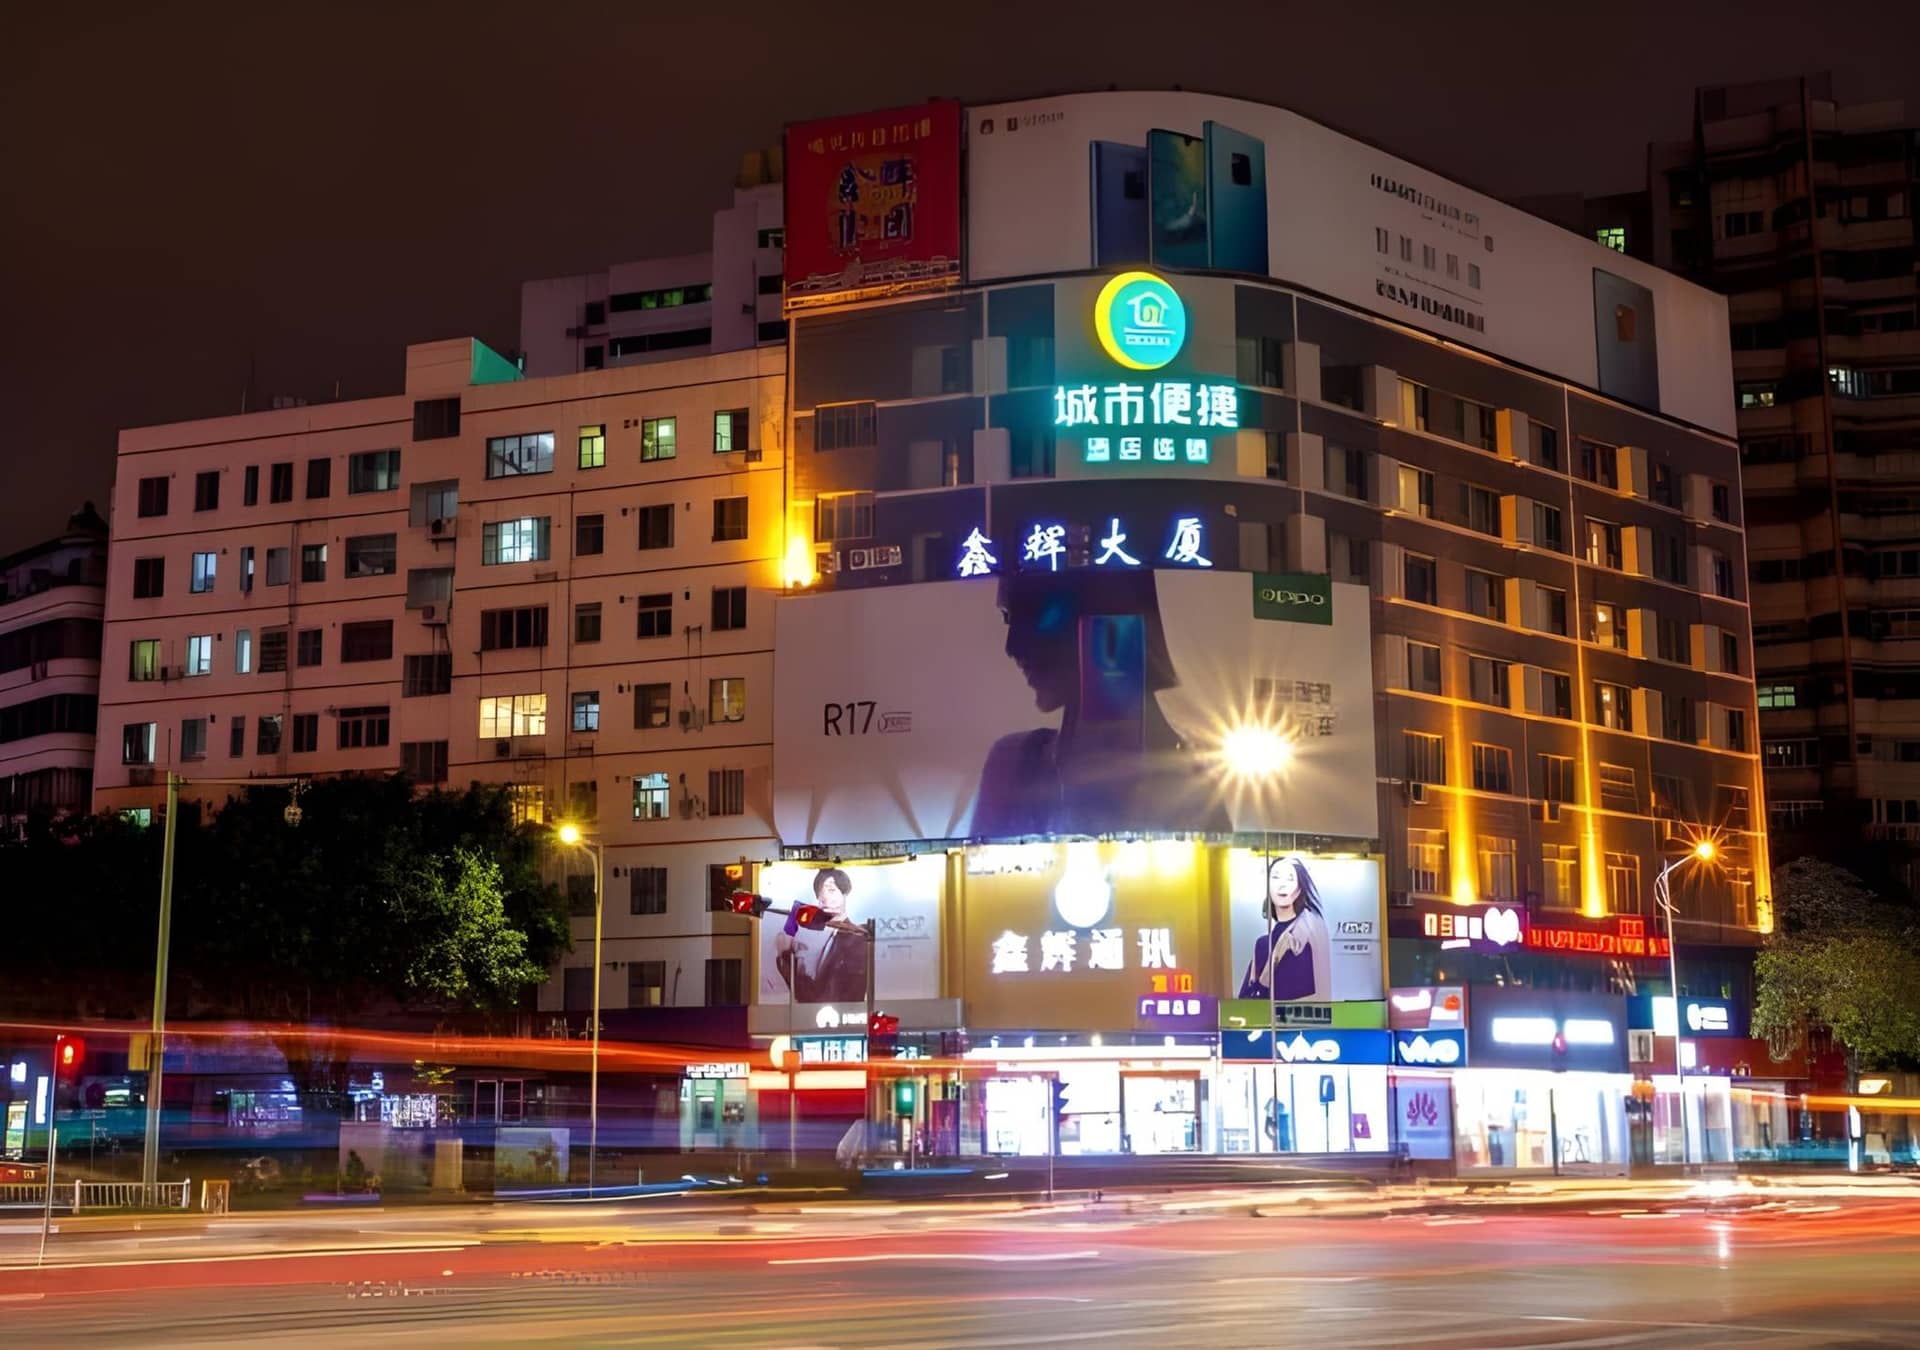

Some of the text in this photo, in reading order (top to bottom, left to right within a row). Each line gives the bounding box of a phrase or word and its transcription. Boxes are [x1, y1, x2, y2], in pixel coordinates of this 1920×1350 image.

[1054, 382, 1239, 427] 城市便捷
[823, 700, 878, 737] R17
